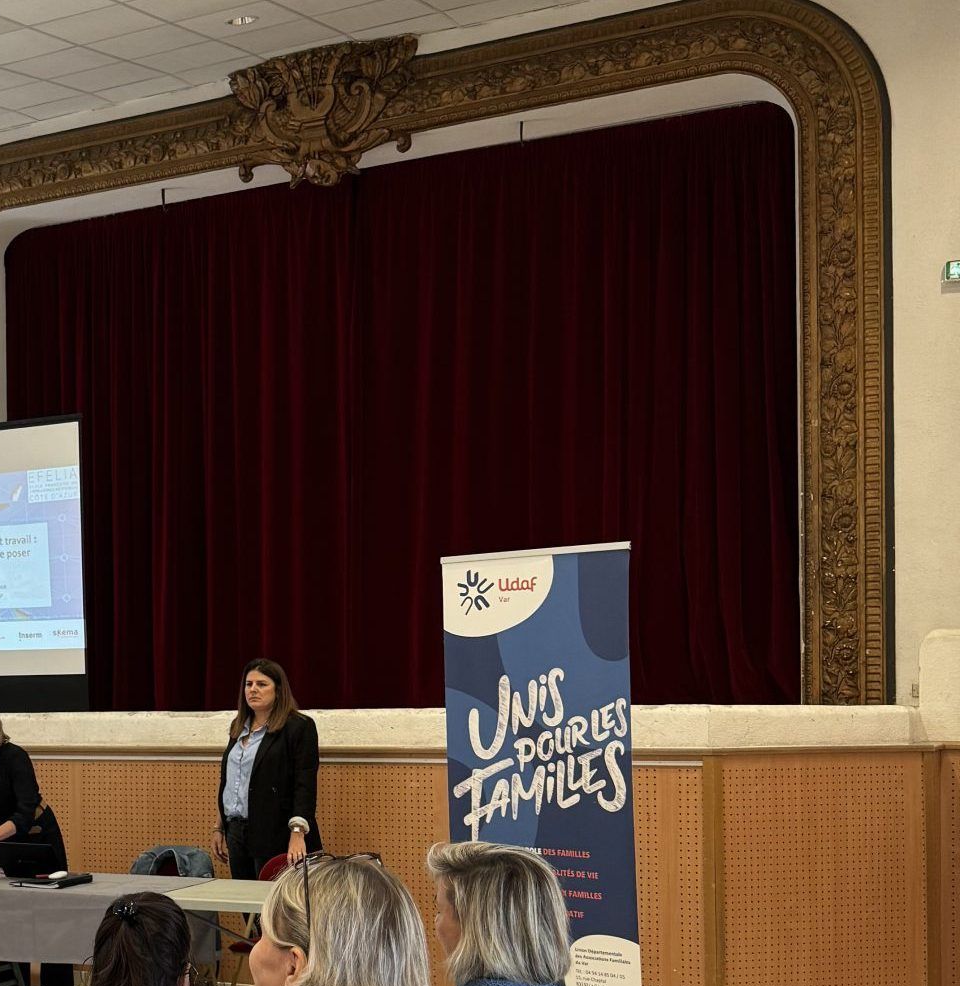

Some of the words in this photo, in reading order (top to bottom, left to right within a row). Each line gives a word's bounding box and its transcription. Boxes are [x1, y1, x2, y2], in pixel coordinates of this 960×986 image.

[4, 534, 32, 545] travail
[6, 549, 31, 561] poser
[498, 576, 537, 592] Udaf
[18, 631, 43, 639] Inserm
[513, 715, 590, 773] POUR
[591, 697, 628, 742] LES
[543, 848, 556, 856] DES
[557, 849, 591, 859] FAMILLES
[575, 870, 586, 879] DE
[586, 871, 600, 880] VIE
[568, 890, 603, 900] FAMILLES
